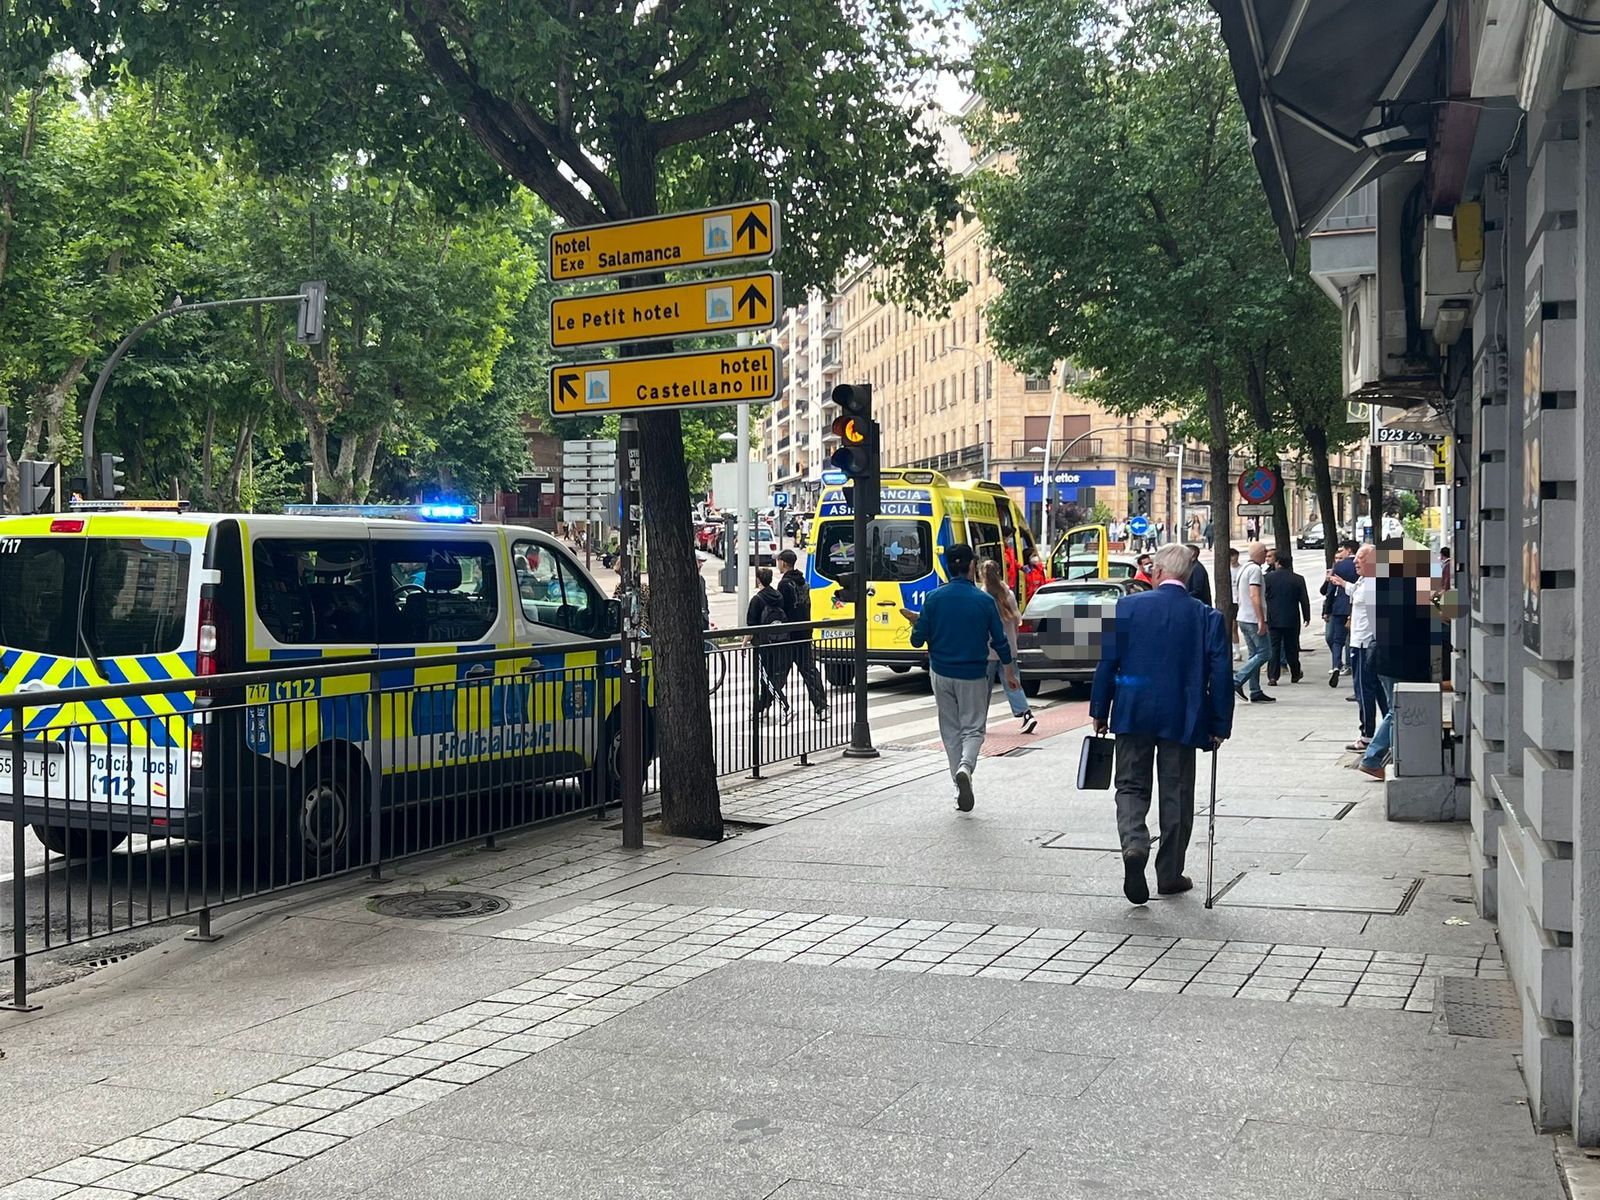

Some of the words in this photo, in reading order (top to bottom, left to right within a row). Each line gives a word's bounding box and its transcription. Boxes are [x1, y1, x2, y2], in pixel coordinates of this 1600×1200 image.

[555, 236, 591, 255] hotel
[560, 258, 585, 272] Exe
[598, 245, 681, 268] Salamanca
[557, 315, 575, 331] Le
[582, 308, 625, 328] Petit
[633, 302, 680, 322] hotel
[720, 356, 768, 375] hotel
[636, 378, 743, 401] Castellano
[1380, 429, 1404, 441] 923
[777, 494, 786, 506] P
[830, 490, 921, 501] AANCIA
[829, 504, 920, 515] ASINCIAL
[1, 539, 22, 554] 717
[248, 684, 268, 699] 717
[282, 678, 316, 699] 112
[0, 757, 27, 776] 55
[142, 757, 178, 776] Local
[98, 775, 136, 798] 112
